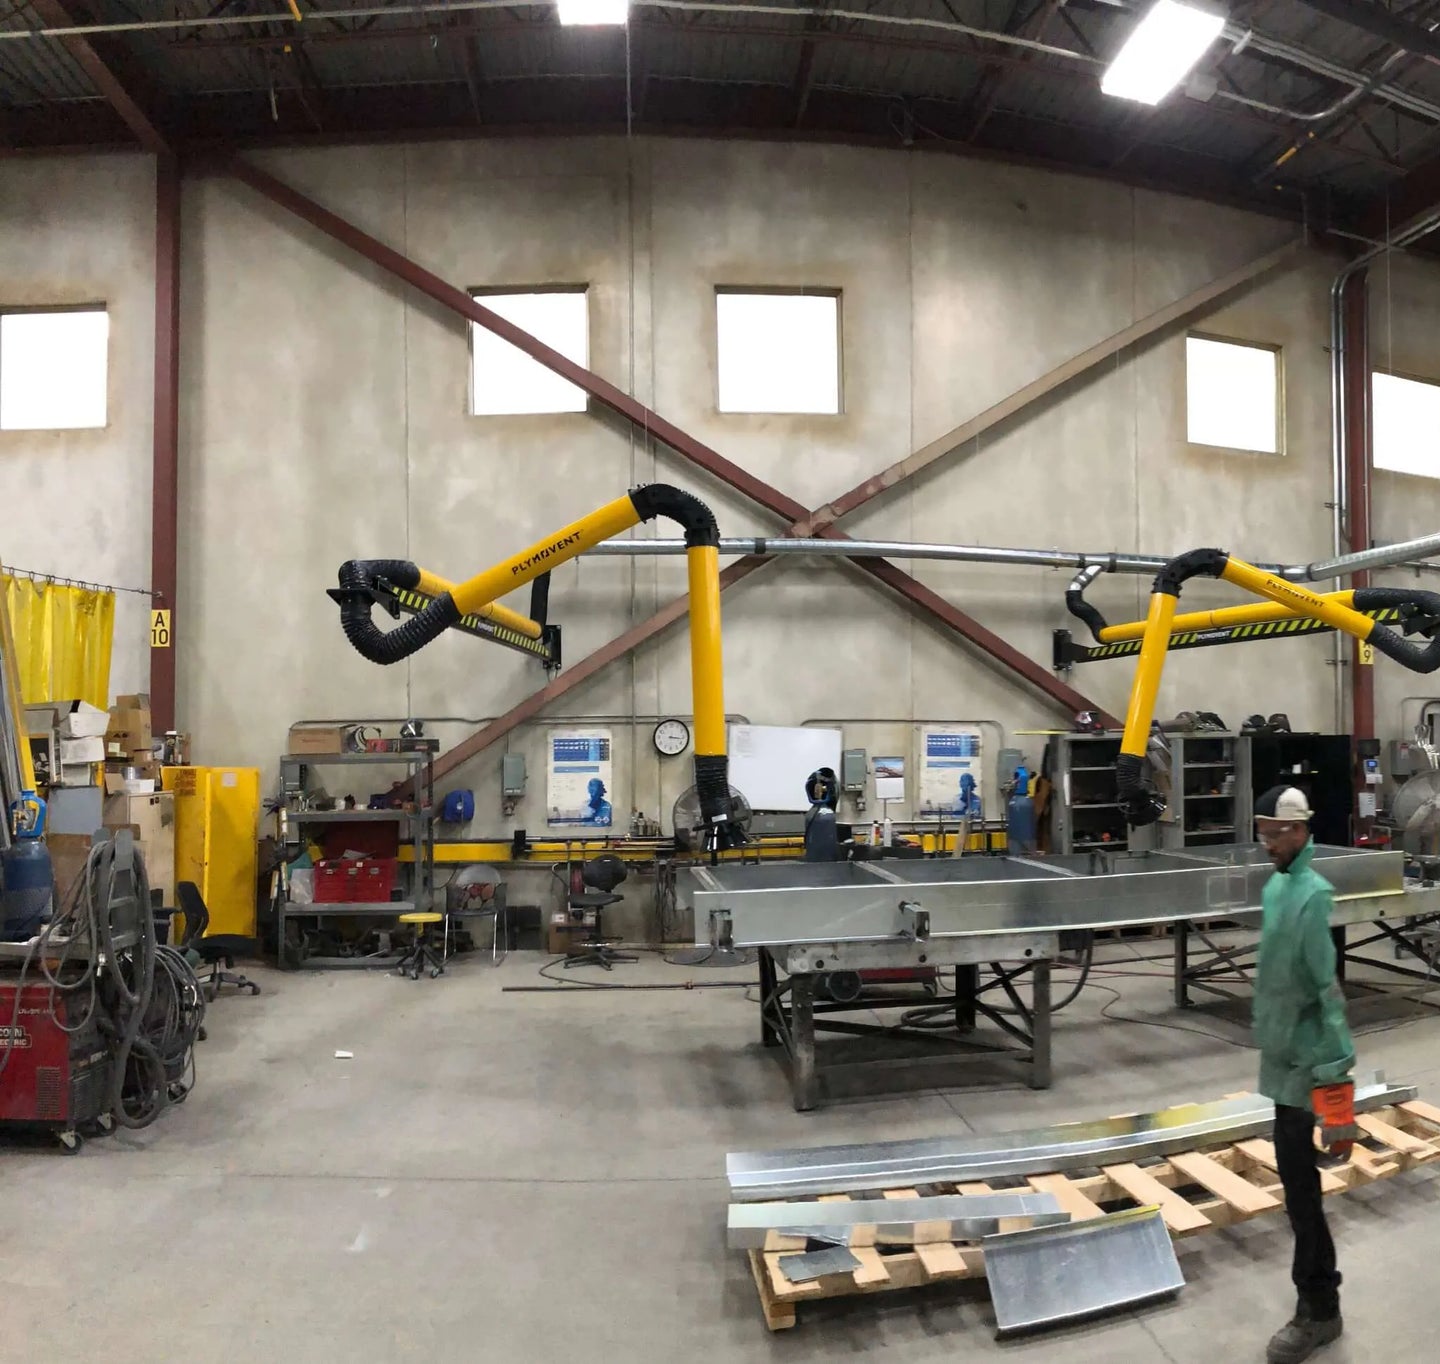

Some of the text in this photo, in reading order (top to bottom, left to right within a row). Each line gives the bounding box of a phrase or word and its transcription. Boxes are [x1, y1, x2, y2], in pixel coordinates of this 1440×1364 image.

[511, 531, 581, 575] PLYMOVENT
[155, 611, 165, 627] A
[151, 629, 168, 645] 10
[1363, 650, 1371, 662] 9
